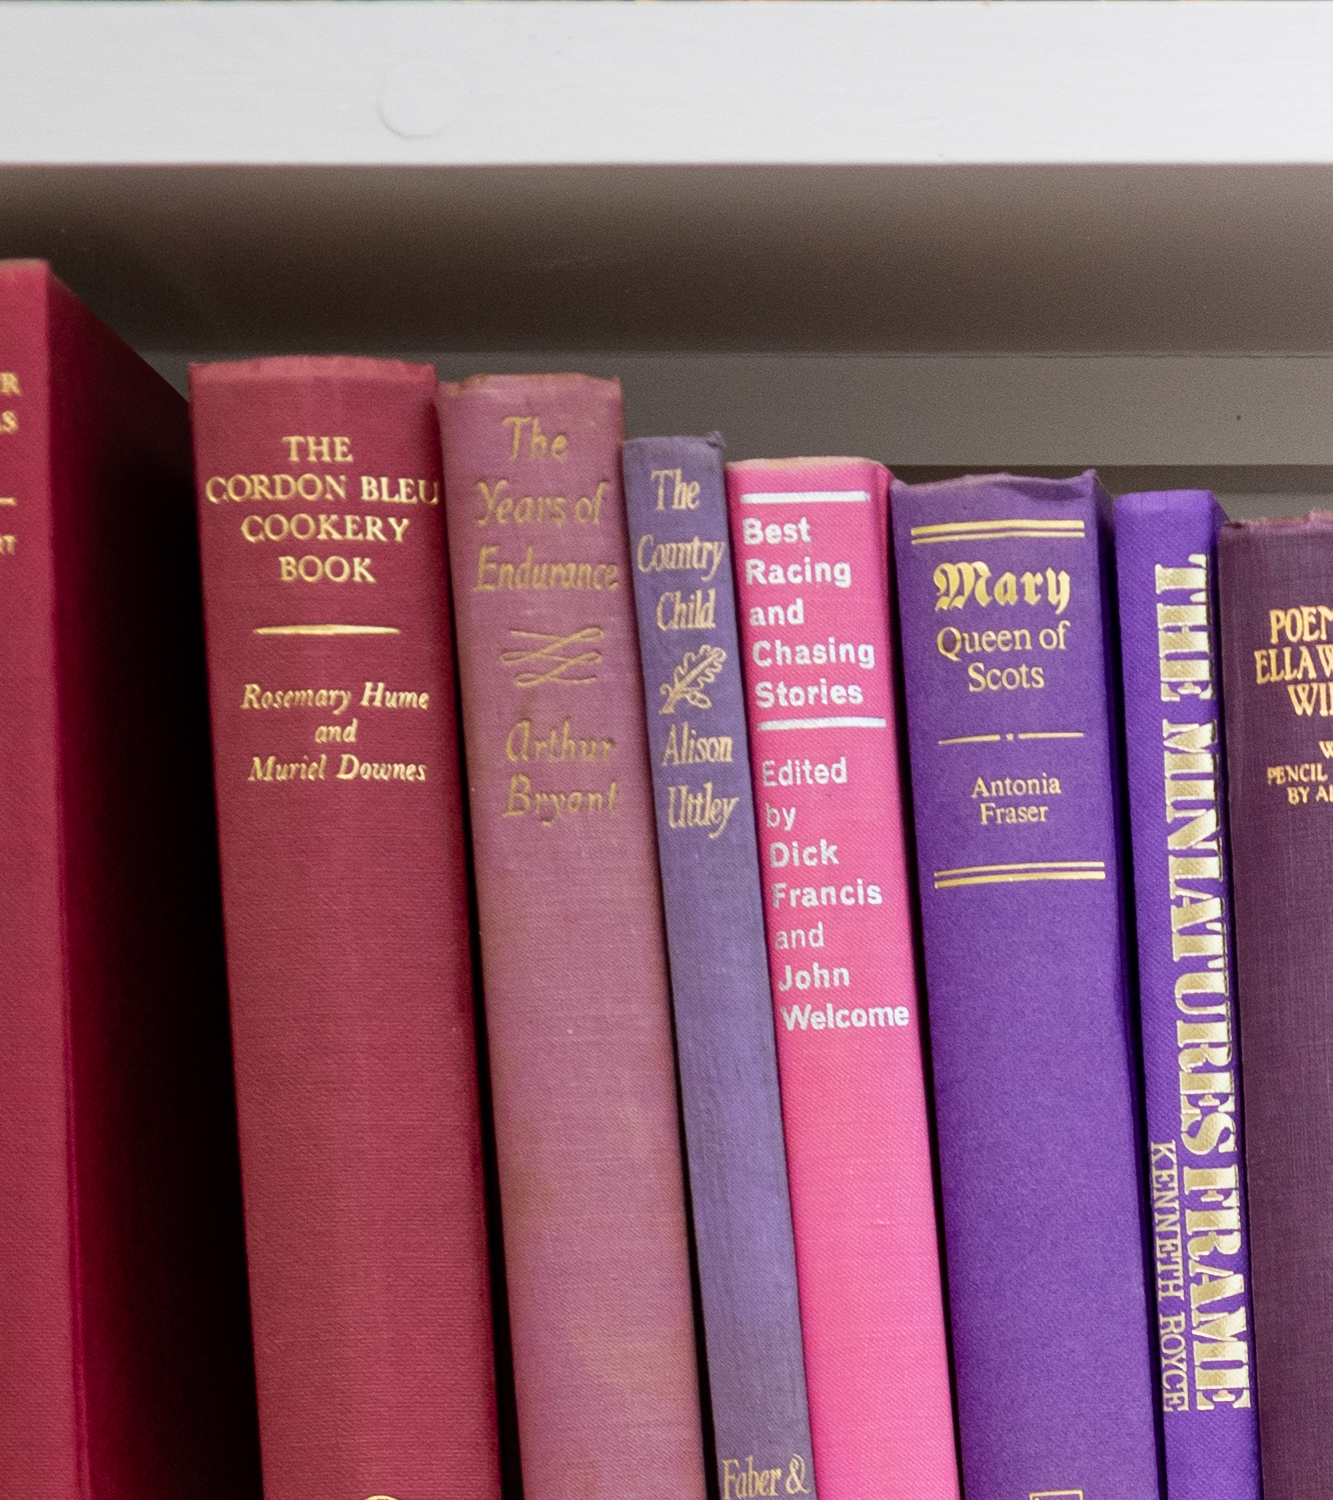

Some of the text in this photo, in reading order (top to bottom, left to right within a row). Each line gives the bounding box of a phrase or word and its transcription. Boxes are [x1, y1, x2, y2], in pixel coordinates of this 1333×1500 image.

[283, 435, 353, 464] THE
[651, 470, 701, 512] The
[240, 515, 410, 544] COOKERY
[741, 518, 811, 545] Best
[636, 533, 725, 578] Country
[279, 556, 376, 585] BOOK
[475, 549, 619, 594] Endurance
[745, 559, 852, 587] Racing
[932, 561, 1071, 613] Mary
[655, 590, 716, 632] Child
[749, 599, 805, 626] and
[751, 639, 876, 669] Chasing
[936, 621, 1071, 661] Queen of
[967, 662, 1046, 694] Scots
[241, 684, 430, 716] Rosemary Hume
[754, 680, 864, 708] Stories
[661, 725, 733, 766] Alison
[248, 755, 427, 783] Muriel Downes
[761, 757, 848, 786] Edited
[1267, 763, 1329, 785] PENCIL
[971, 775, 1062, 799] Antonia
[1286, 784, 1310, 805] BY
[978, 802, 1049, 826] Fraser
[769, 840, 840, 867] Dick
[771, 881, 883, 908] Francis
[778, 962, 851, 989] John
[781, 1003, 911, 1032] Welcome
[1149, 1140, 1190, 1413] KENNETH ROYCE
